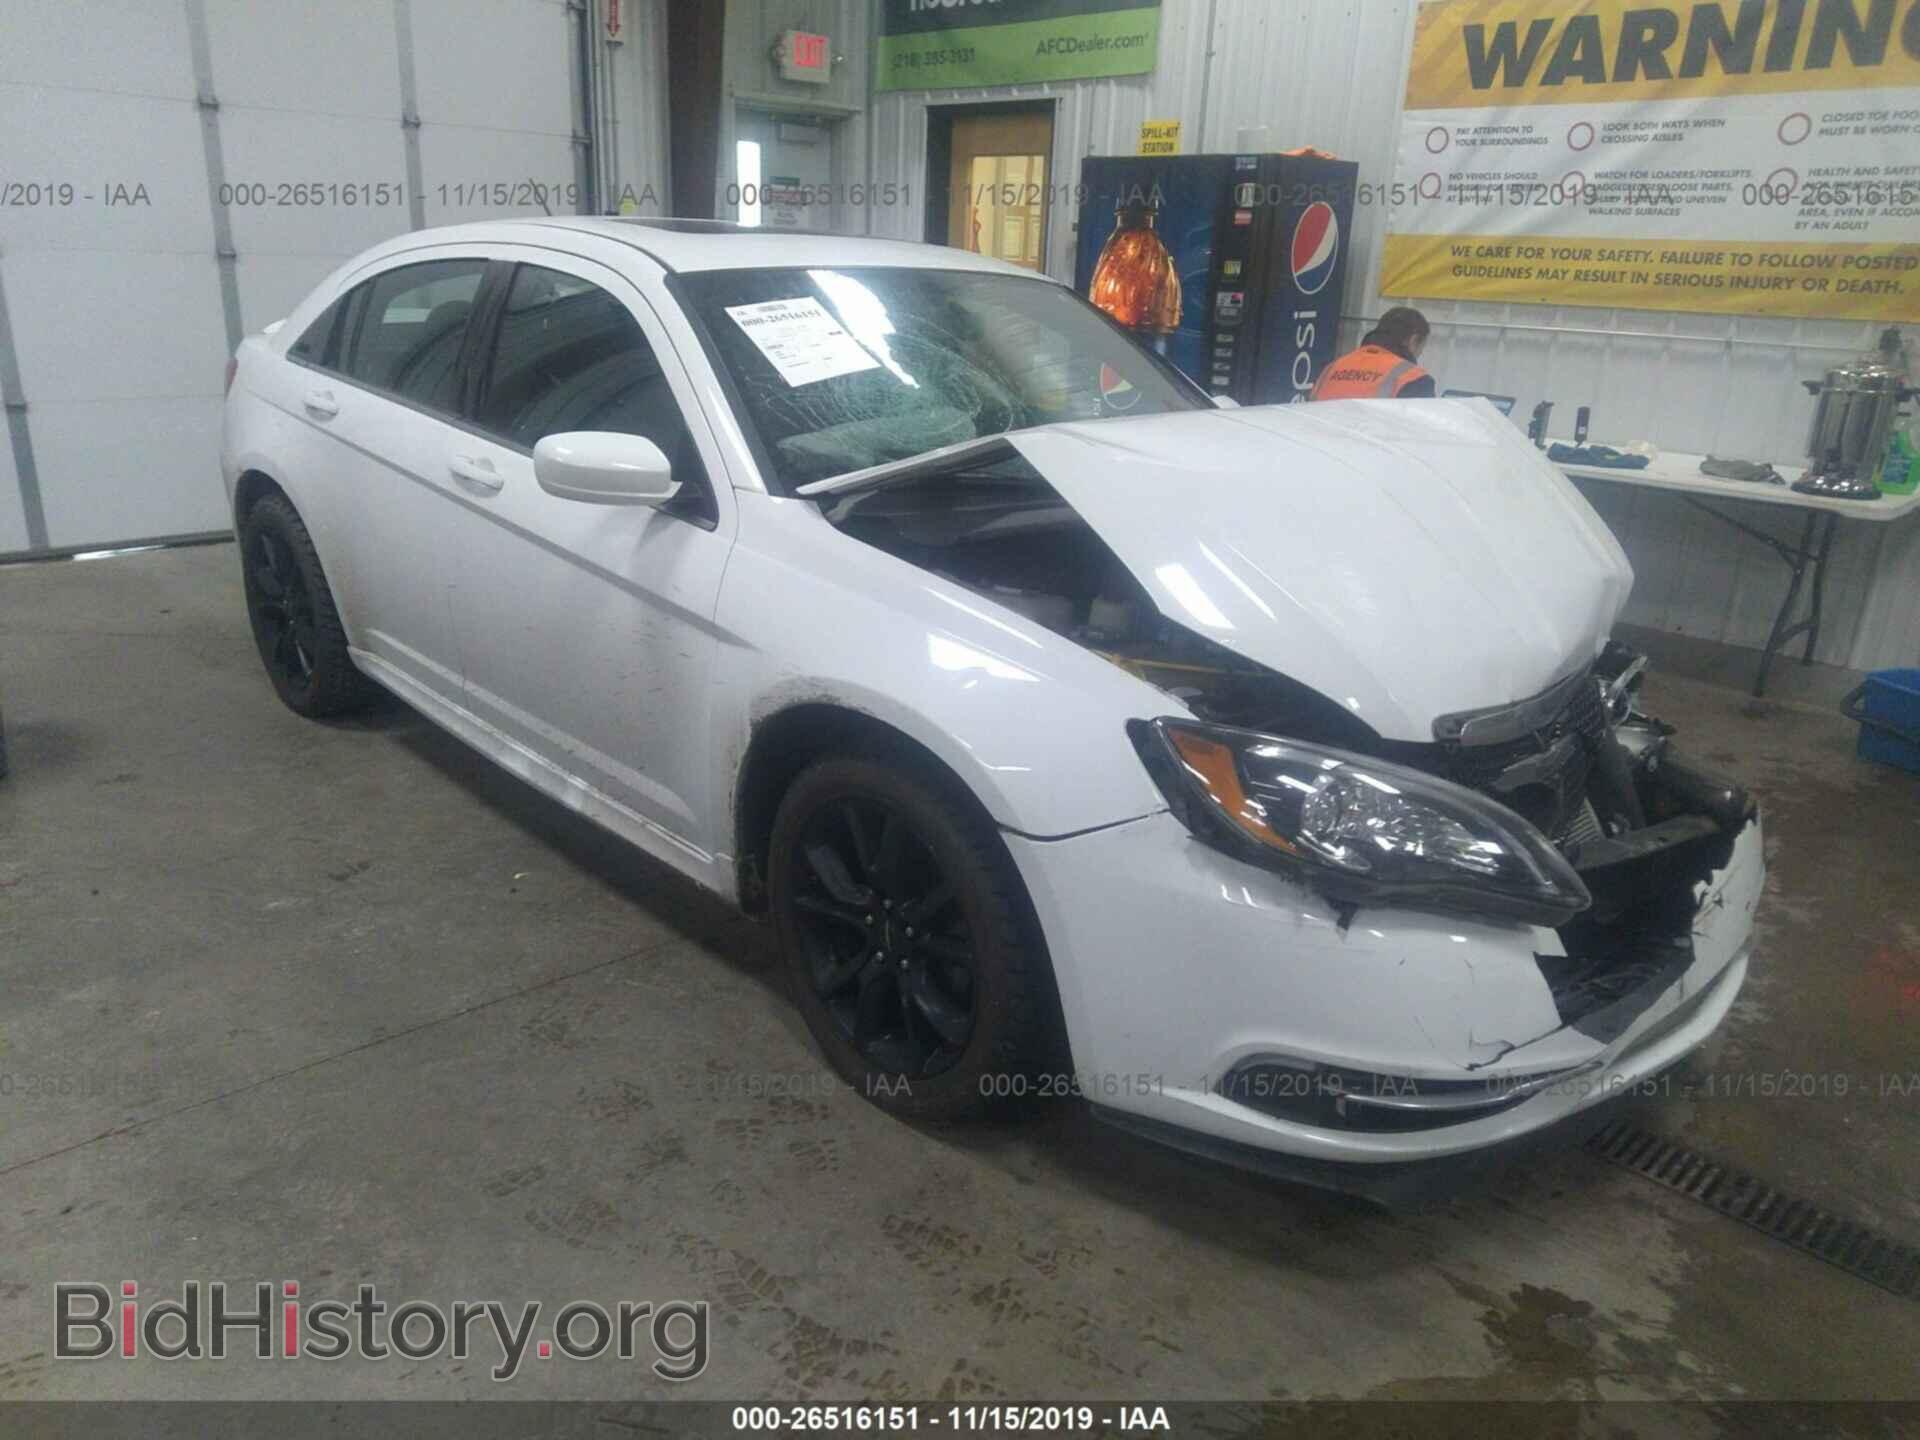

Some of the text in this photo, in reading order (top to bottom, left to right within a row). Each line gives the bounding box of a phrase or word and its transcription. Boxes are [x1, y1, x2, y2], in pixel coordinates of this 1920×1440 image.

[795, 32, 828, 68] EXIT
[1036, 34, 1145, 56] AFCDealer.com
[1463, 0, 1920, 90] WARNIN
[1662, 120, 1690, 130] WAYS
[1692, 118, 1726, 129] WHEN
[1474, 126, 1519, 135] ATTENTION
[1521, 125, 1534, 134] TO
[1479, 136, 1549, 146] SURROUNDINGS
[1142, 142, 1174, 153] STATION
[1853, 166, 1880, 176] AND
[1589, 207, 1681, 217] WALKING SURFACES
[1811, 221, 1829, 230] AN
[1452, 245, 1919, 271] WE CARE FOR YOUR SAFETY. FAILURE TO FOLLOW POSTED
[1452, 264, 1904, 294] GUIDELINES MAY RESULT IN SERIOUS INJURY OR DEATH.
